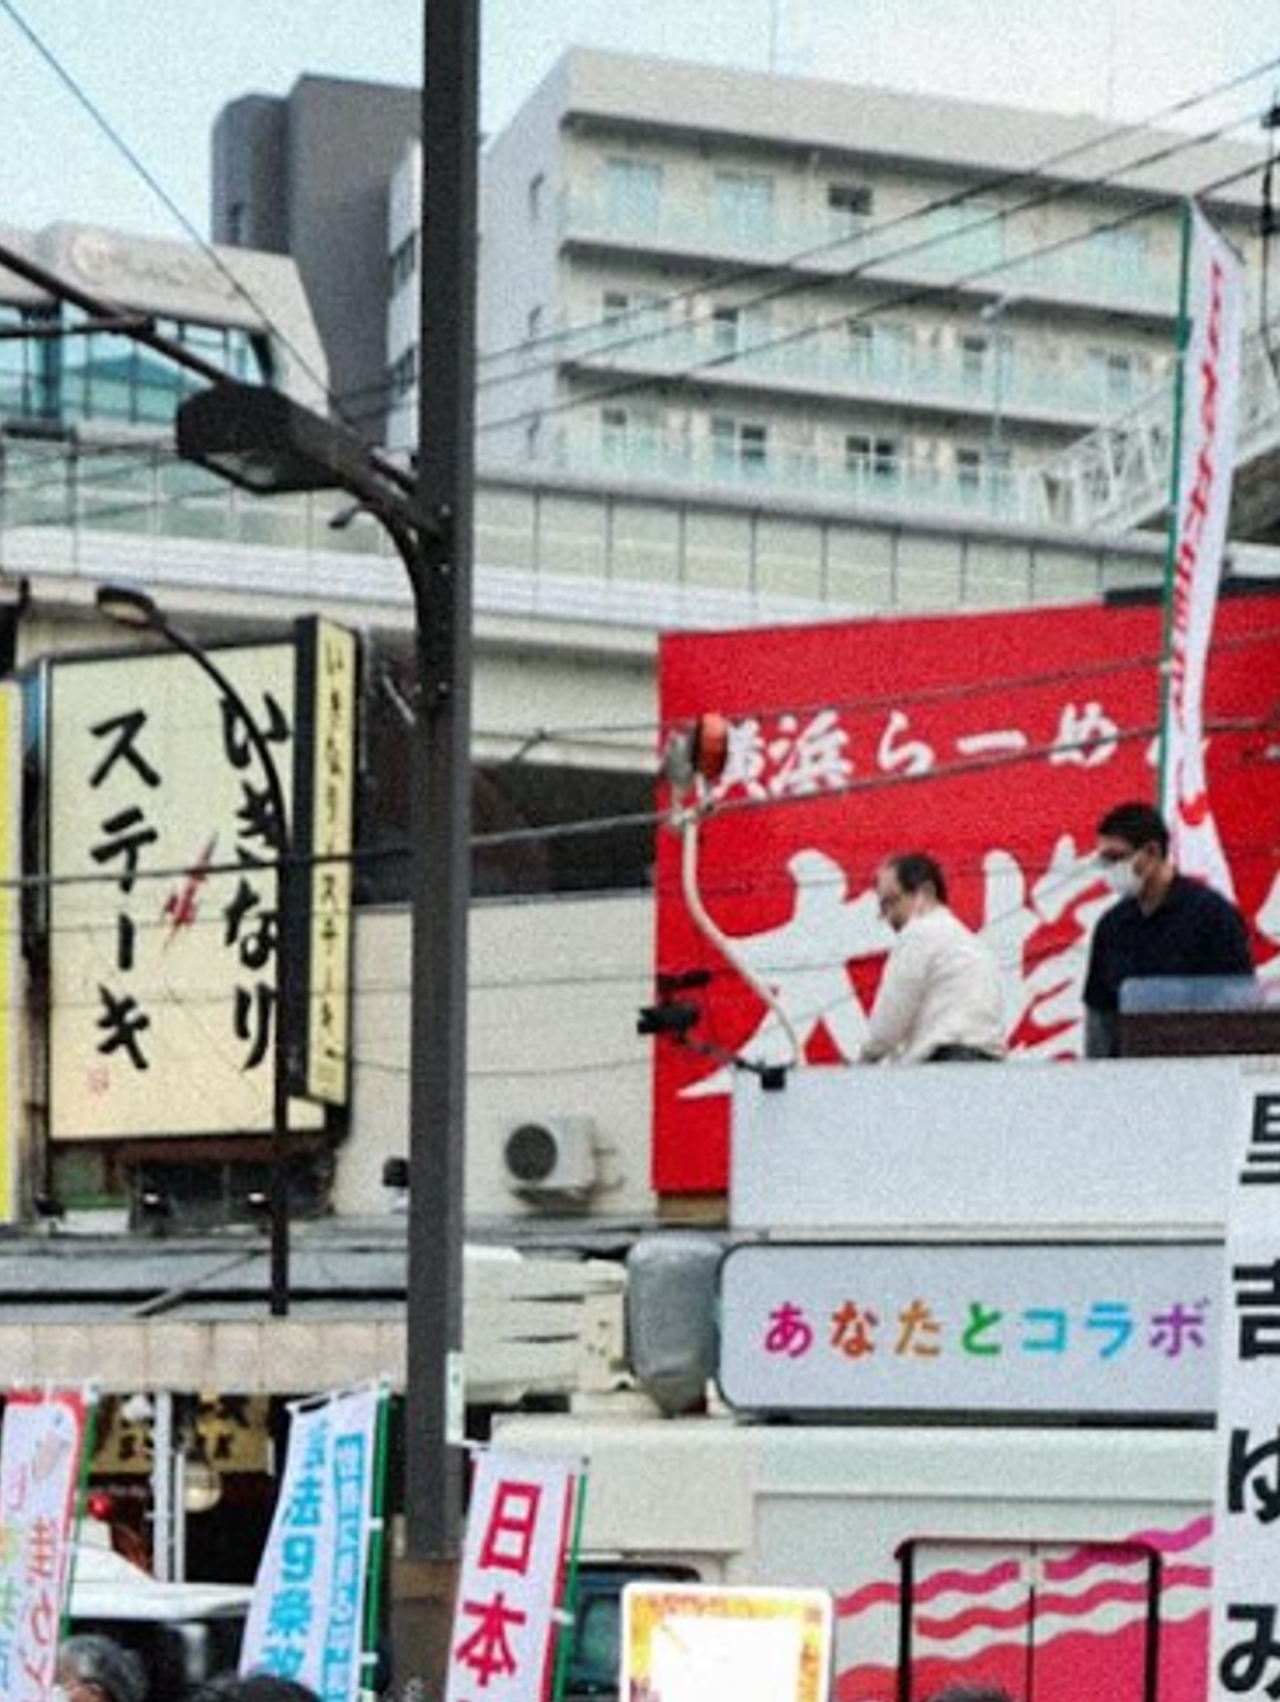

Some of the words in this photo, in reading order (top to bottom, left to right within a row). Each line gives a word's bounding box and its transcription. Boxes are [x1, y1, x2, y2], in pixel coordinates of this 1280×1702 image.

[697, 702, 1210, 800] 横浜らーめ
[89, 709, 161, 1070] ステーキ
[219, 691, 291, 1072] いきなり
[764, 1298, 1210, 1359] あなたとコラボ
